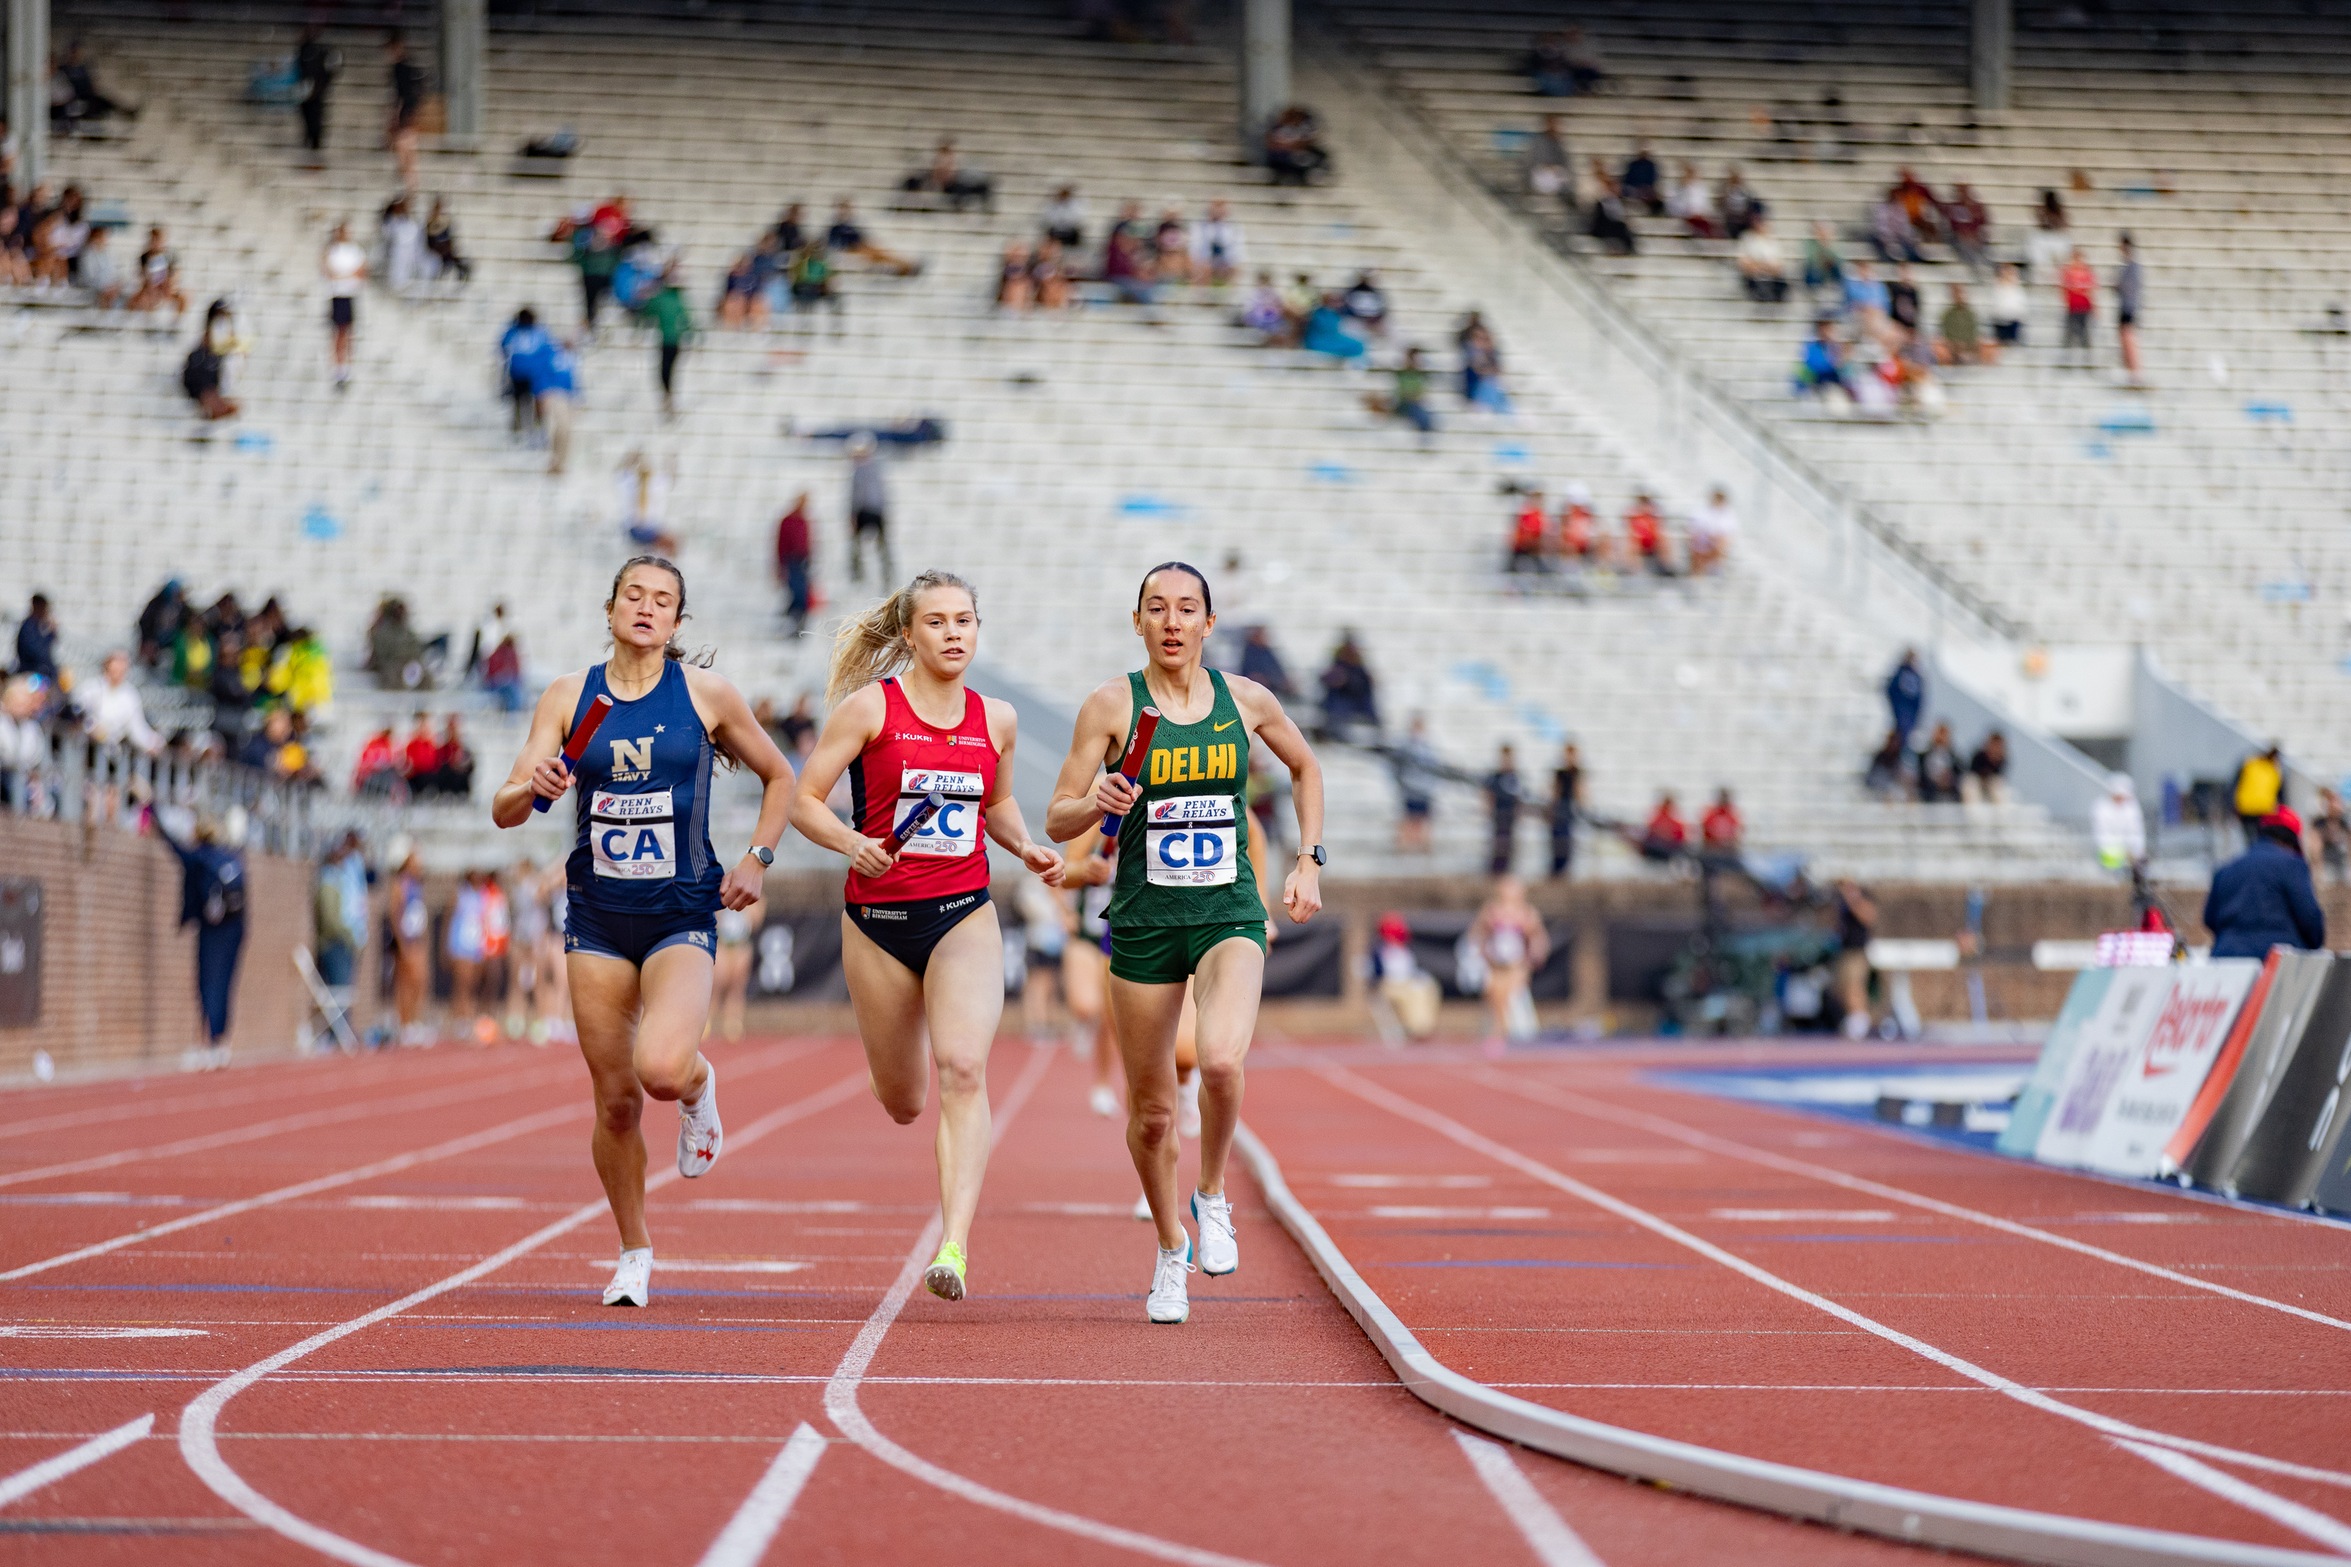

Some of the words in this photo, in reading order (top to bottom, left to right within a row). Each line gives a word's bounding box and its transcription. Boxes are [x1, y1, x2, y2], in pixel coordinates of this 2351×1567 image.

[902, 733, 933, 742] KUKRI
[610, 736, 654, 773] N
[1151, 743, 1237, 785] DELHI
[612, 771, 651, 782] NAVY
[935, 775, 965, 784] PENN
[934, 783, 975, 793] RELAYS
[620, 797, 653, 807] PENN
[1185, 800, 1216, 809] PENN
[619, 805, 663, 815] RELAYS
[1182, 808, 1227, 818] RELAYS
[900, 819, 920, 841] RELAYS
[601, 828, 665, 861] CA
[934, 840, 957, 852] 250
[1159, 832, 1223, 868] CD
[631, 863, 655, 875] 250
[1191, 870, 1215, 883] 250
[946, 895, 975, 911] KUKRI
